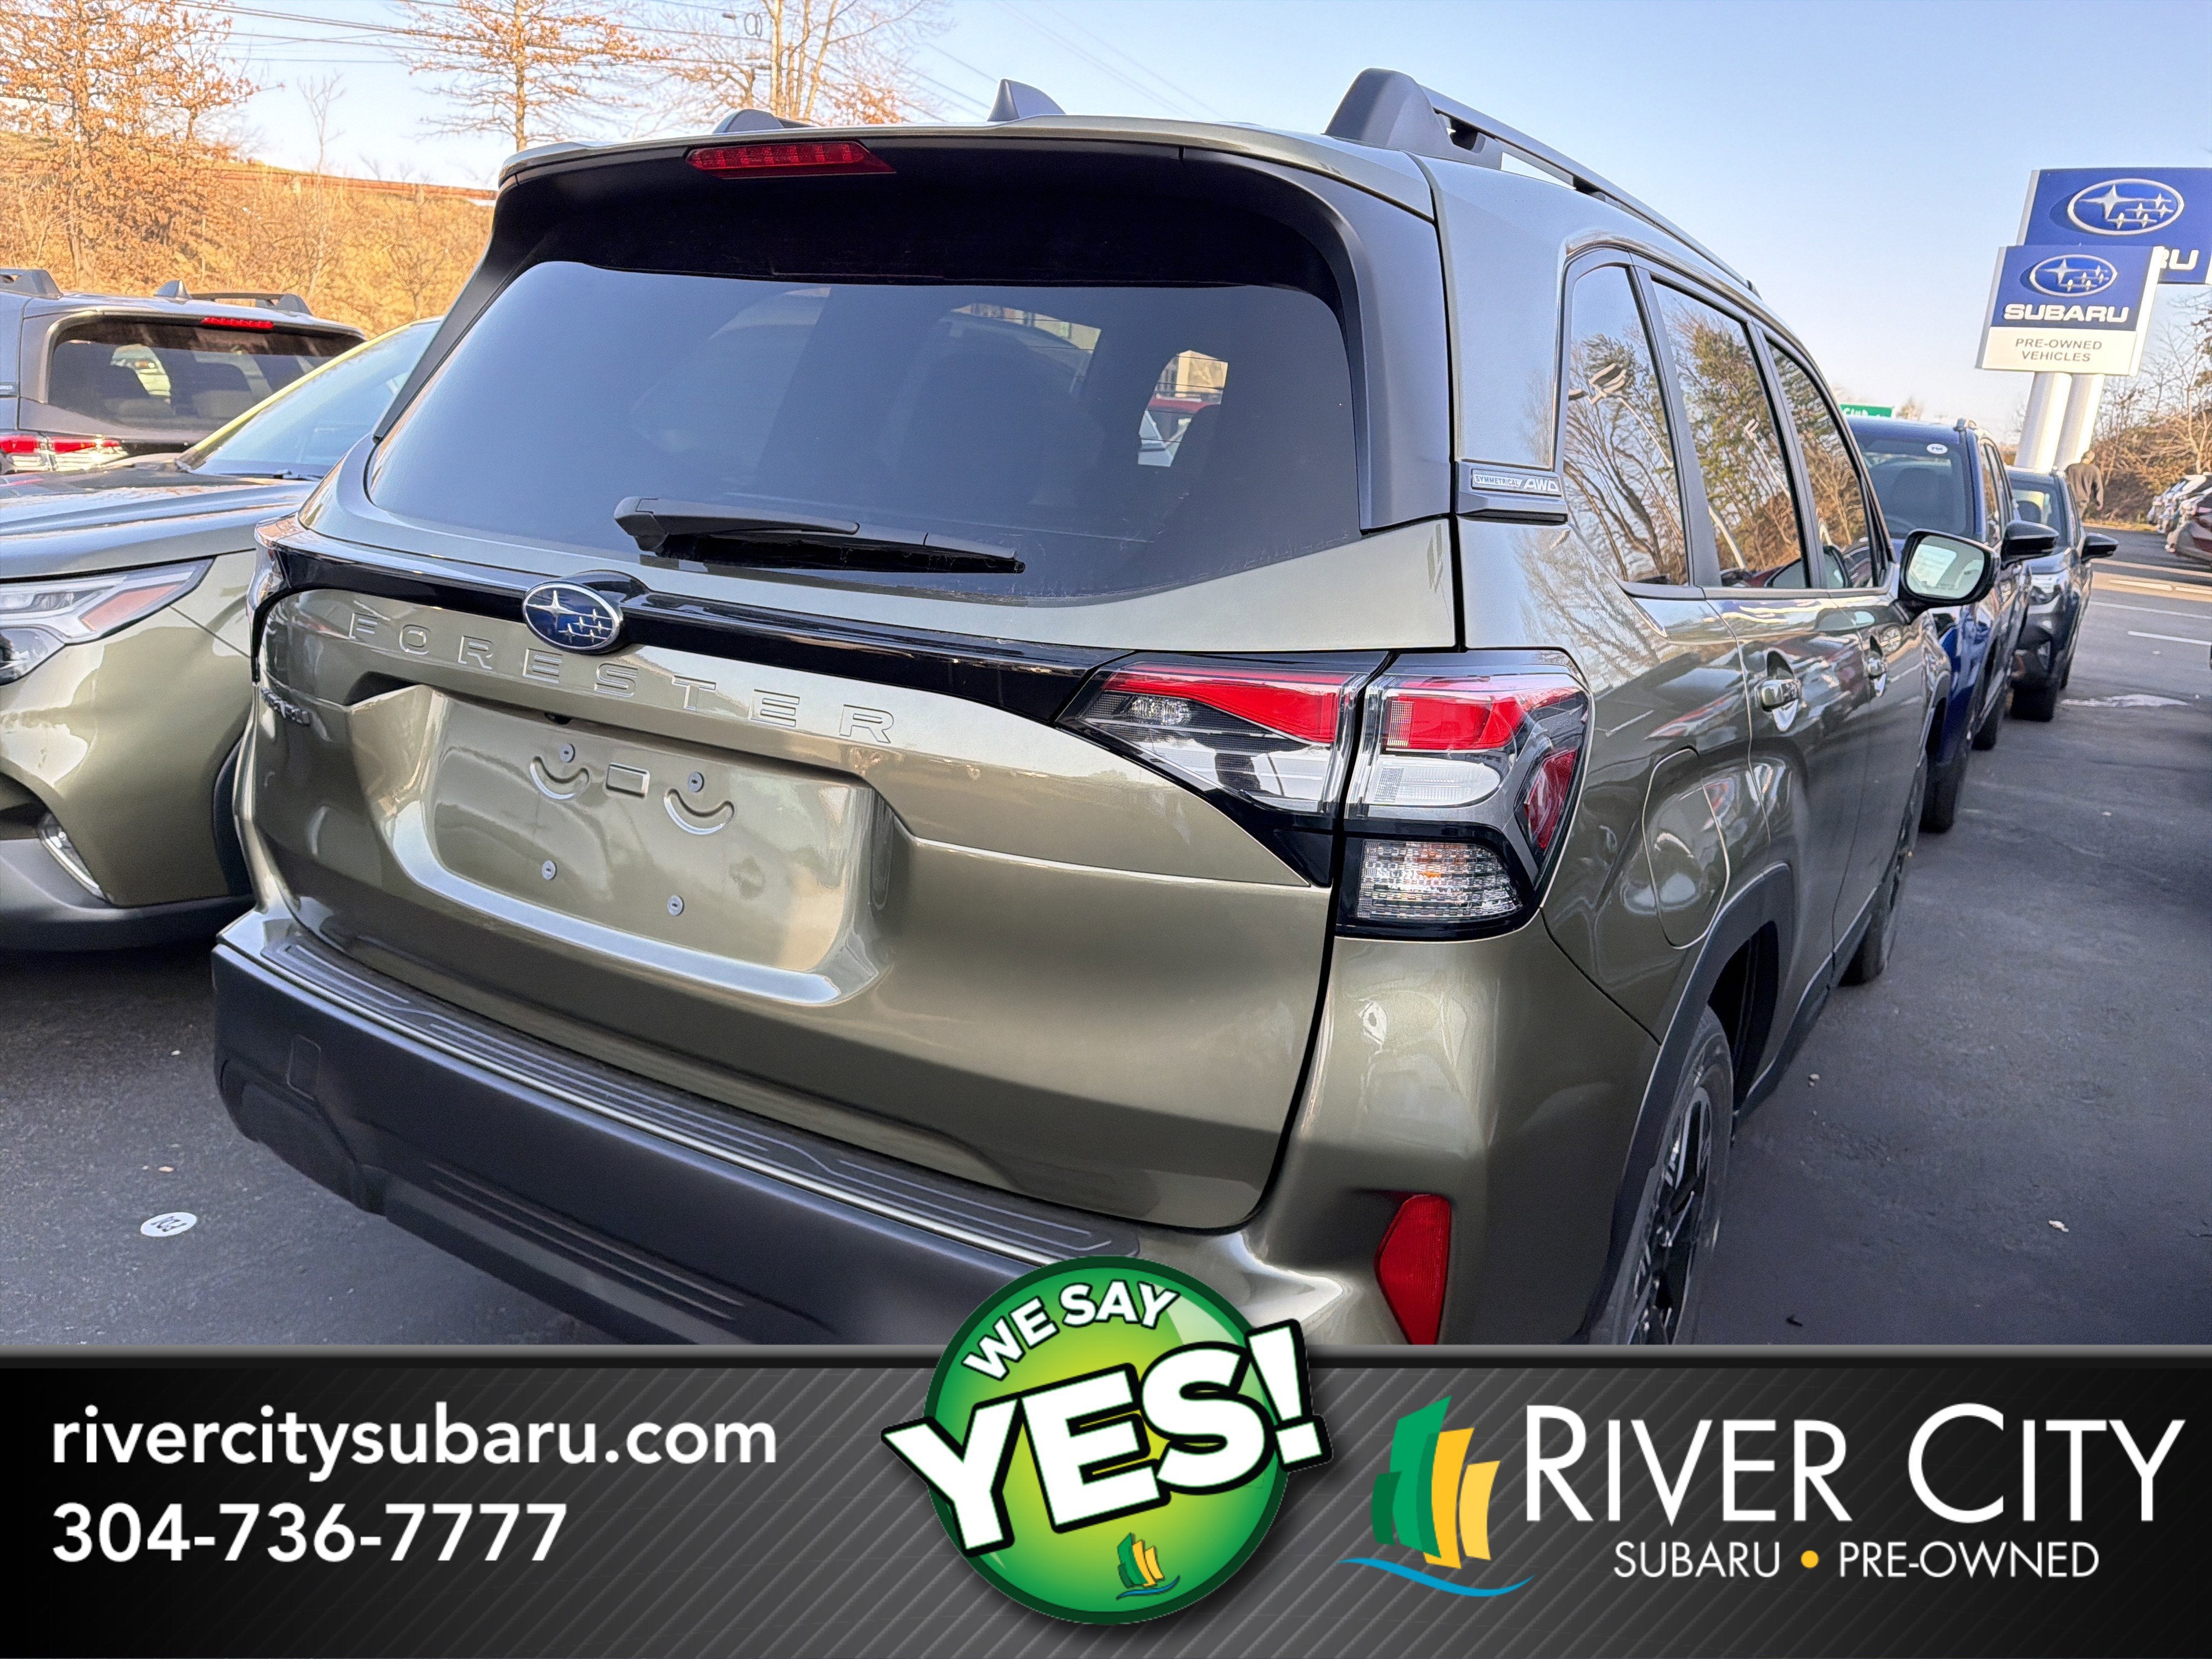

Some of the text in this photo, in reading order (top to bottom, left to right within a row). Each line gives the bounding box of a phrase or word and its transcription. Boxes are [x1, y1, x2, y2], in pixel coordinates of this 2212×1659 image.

[2004, 303, 2130, 323] SUBARU
[2015, 338, 2102, 350] PRE-OWNED
[2022, 350, 2091, 362] VEHICLES
[1475, 475, 1559, 492] SYMMETRICAL AWD
[349, 612, 894, 744] FORESTER
